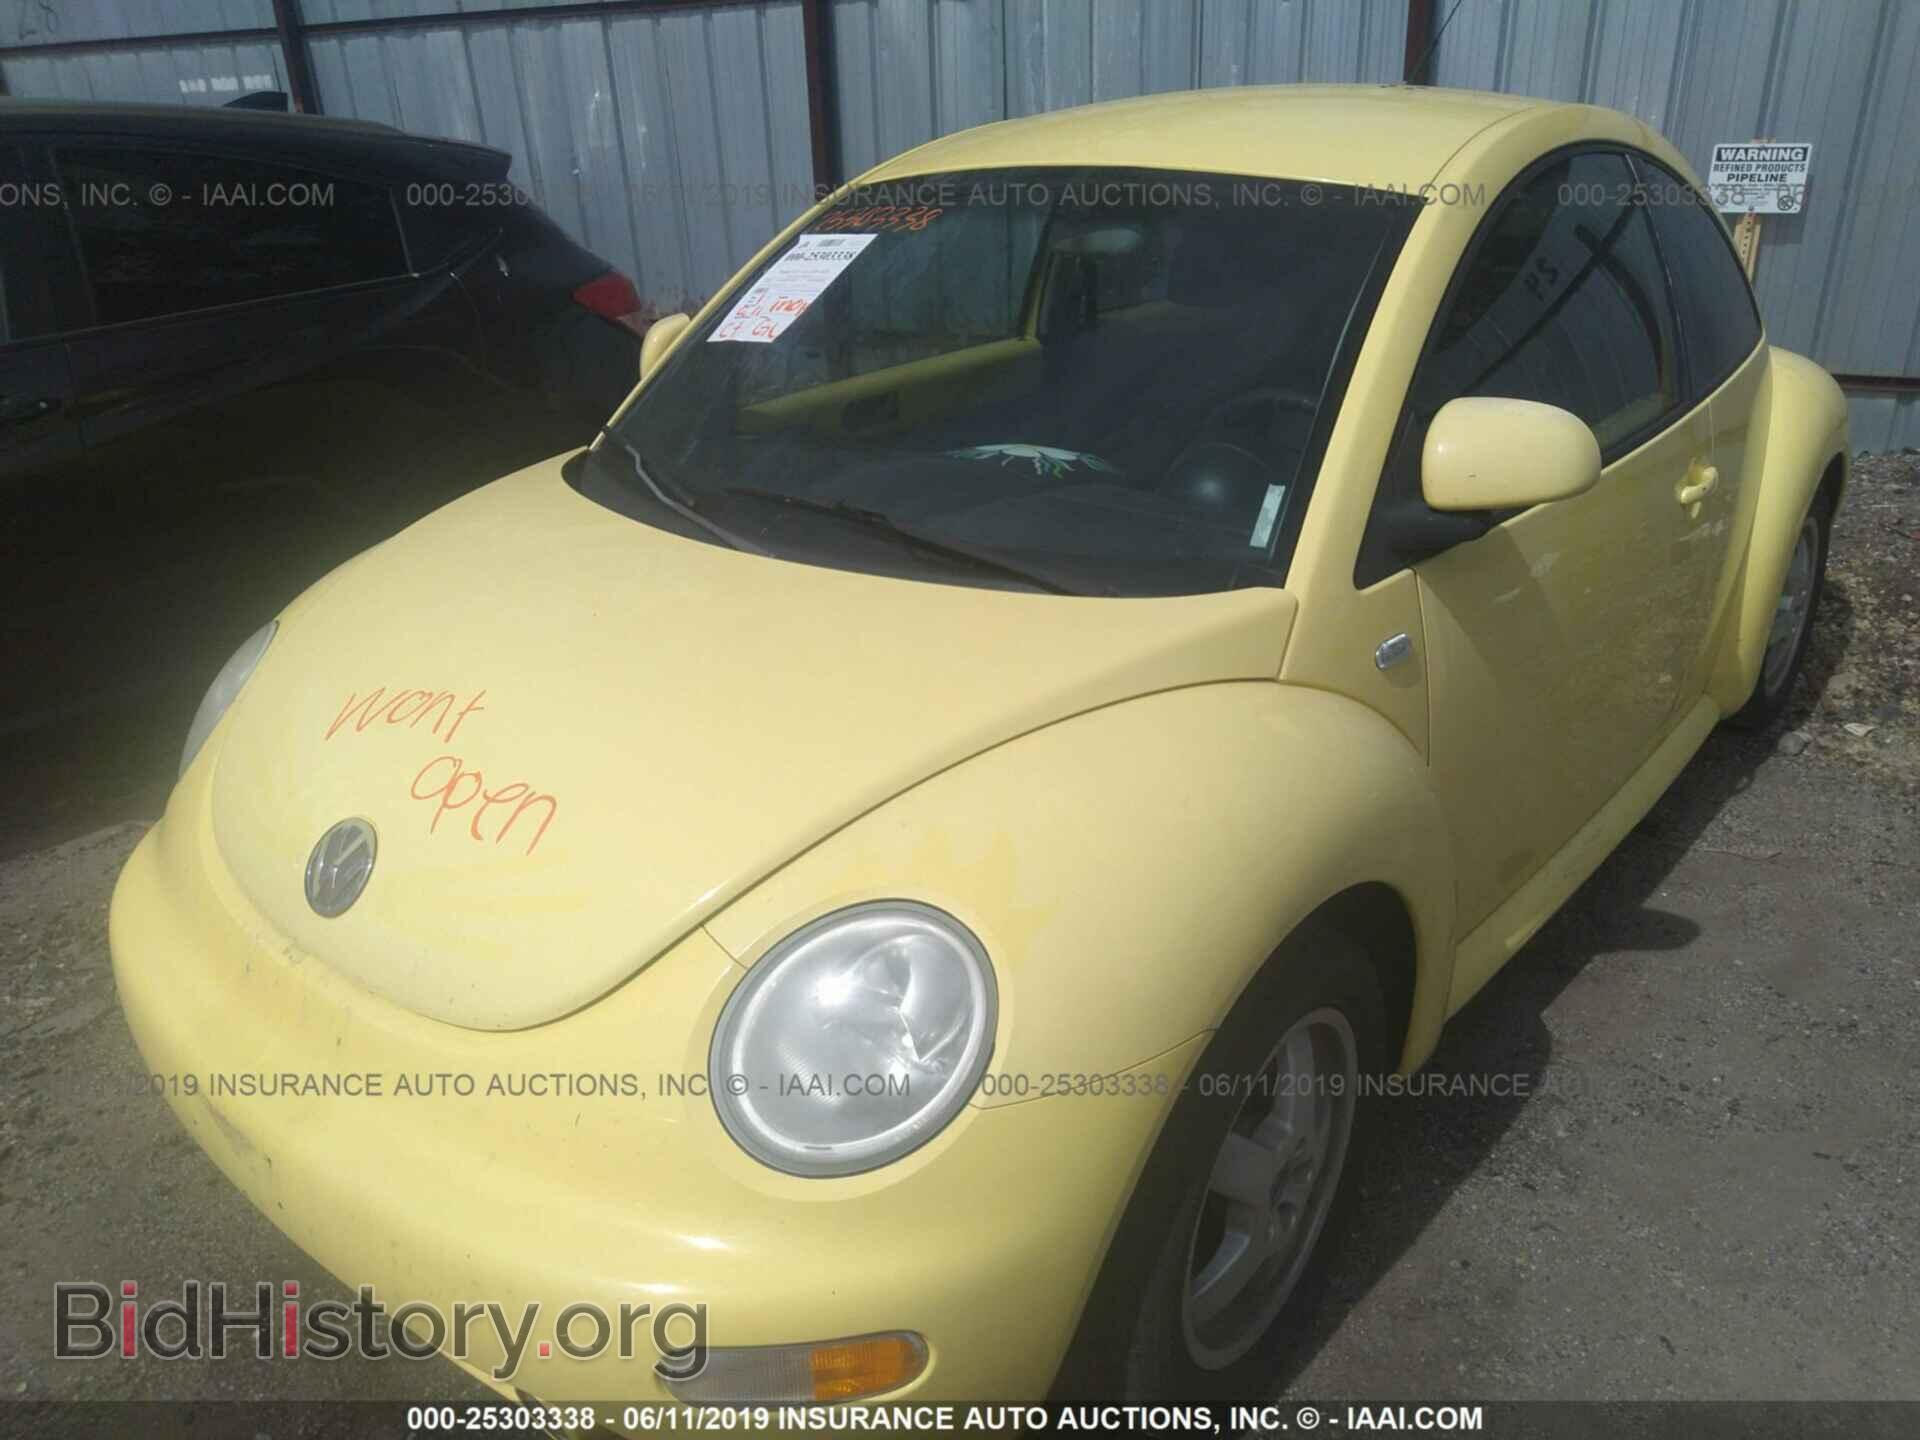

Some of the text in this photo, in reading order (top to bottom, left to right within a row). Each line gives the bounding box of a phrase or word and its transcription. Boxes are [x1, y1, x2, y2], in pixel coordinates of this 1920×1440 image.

[1720, 148, 1804, 161] WARNING
[1713, 163, 1805, 173] REFINED PRODUCTS
[1726, 173, 1788, 182] PIPELINE
